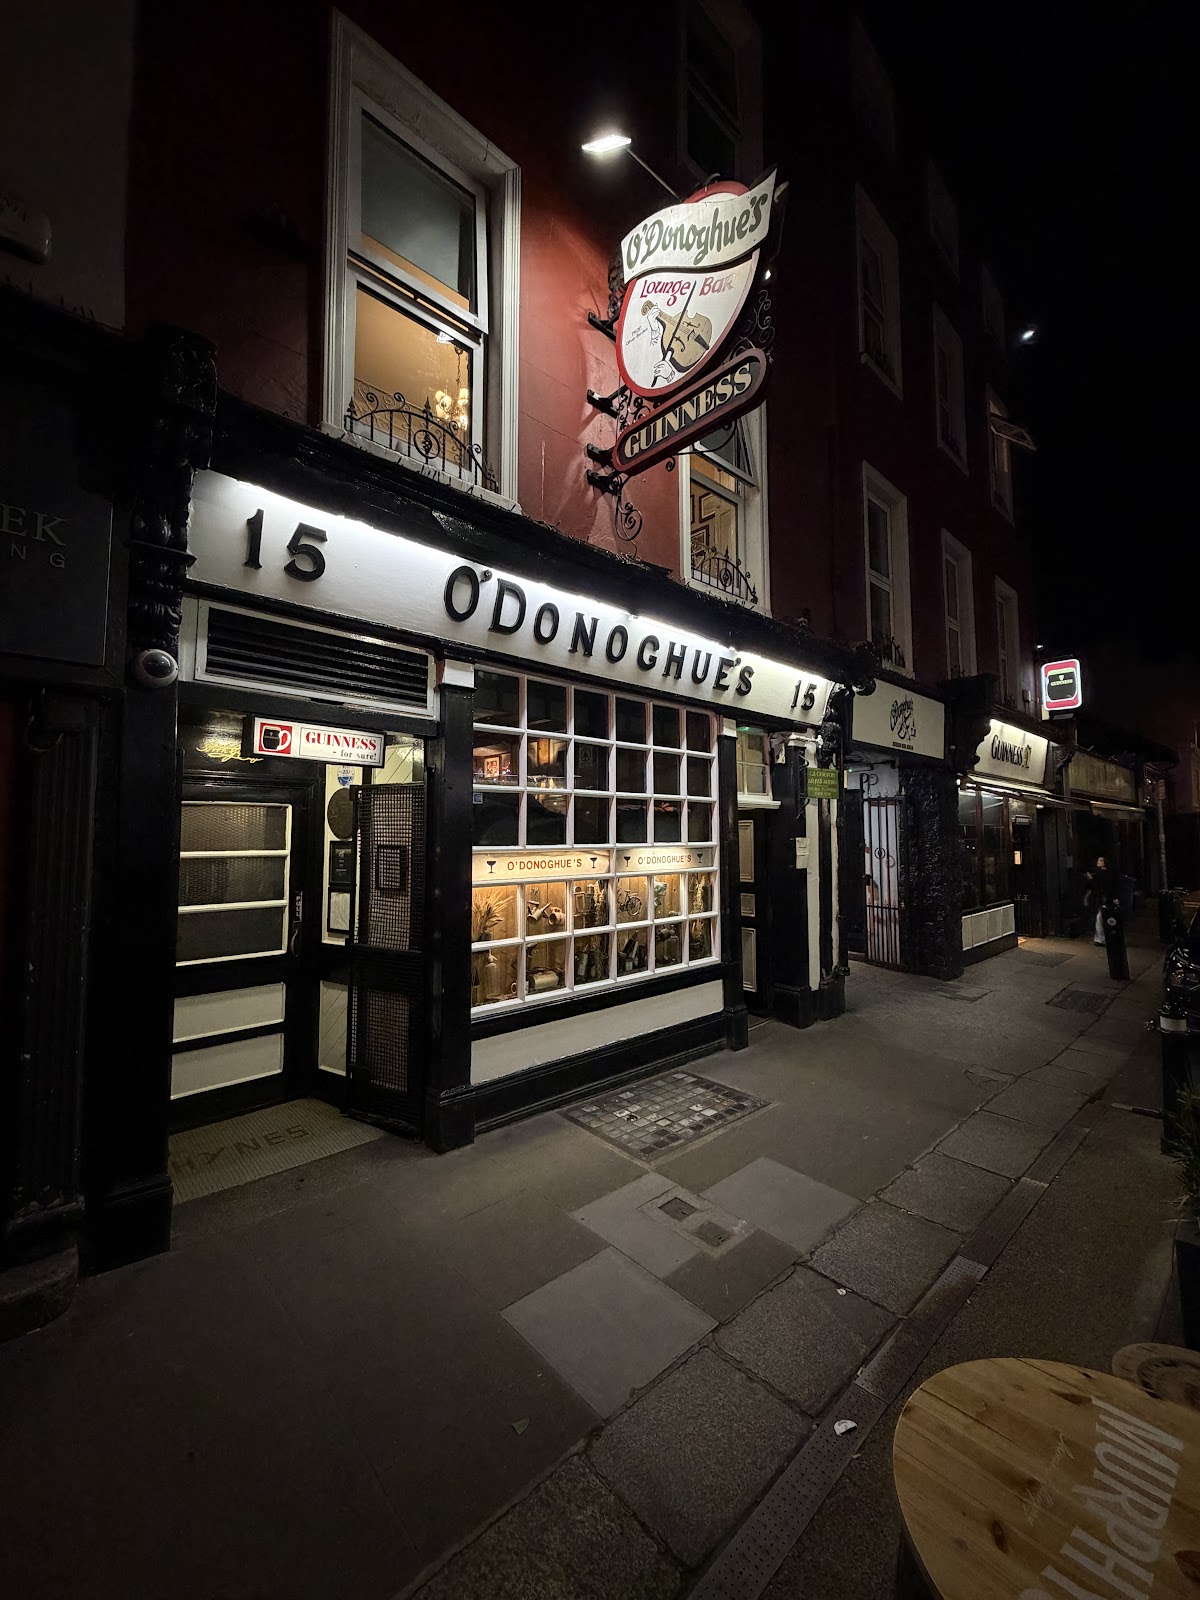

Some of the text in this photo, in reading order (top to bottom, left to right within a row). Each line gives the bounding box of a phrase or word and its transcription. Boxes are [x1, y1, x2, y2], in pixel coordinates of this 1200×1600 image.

[640, 279, 691, 306] Lounge
[624, 362, 753, 458] GUINNESS
[242, 508, 328, 582] 15
[443, 565, 817, 711] O'DONOGHUE'S 15
[305, 731, 377, 751] GUINNESS
[340, 749, 377, 761] for sure!
[507, 858, 583, 871] O'DONOGHUE'S
[637, 854, 692, 866] O'DONOGHUE'S
